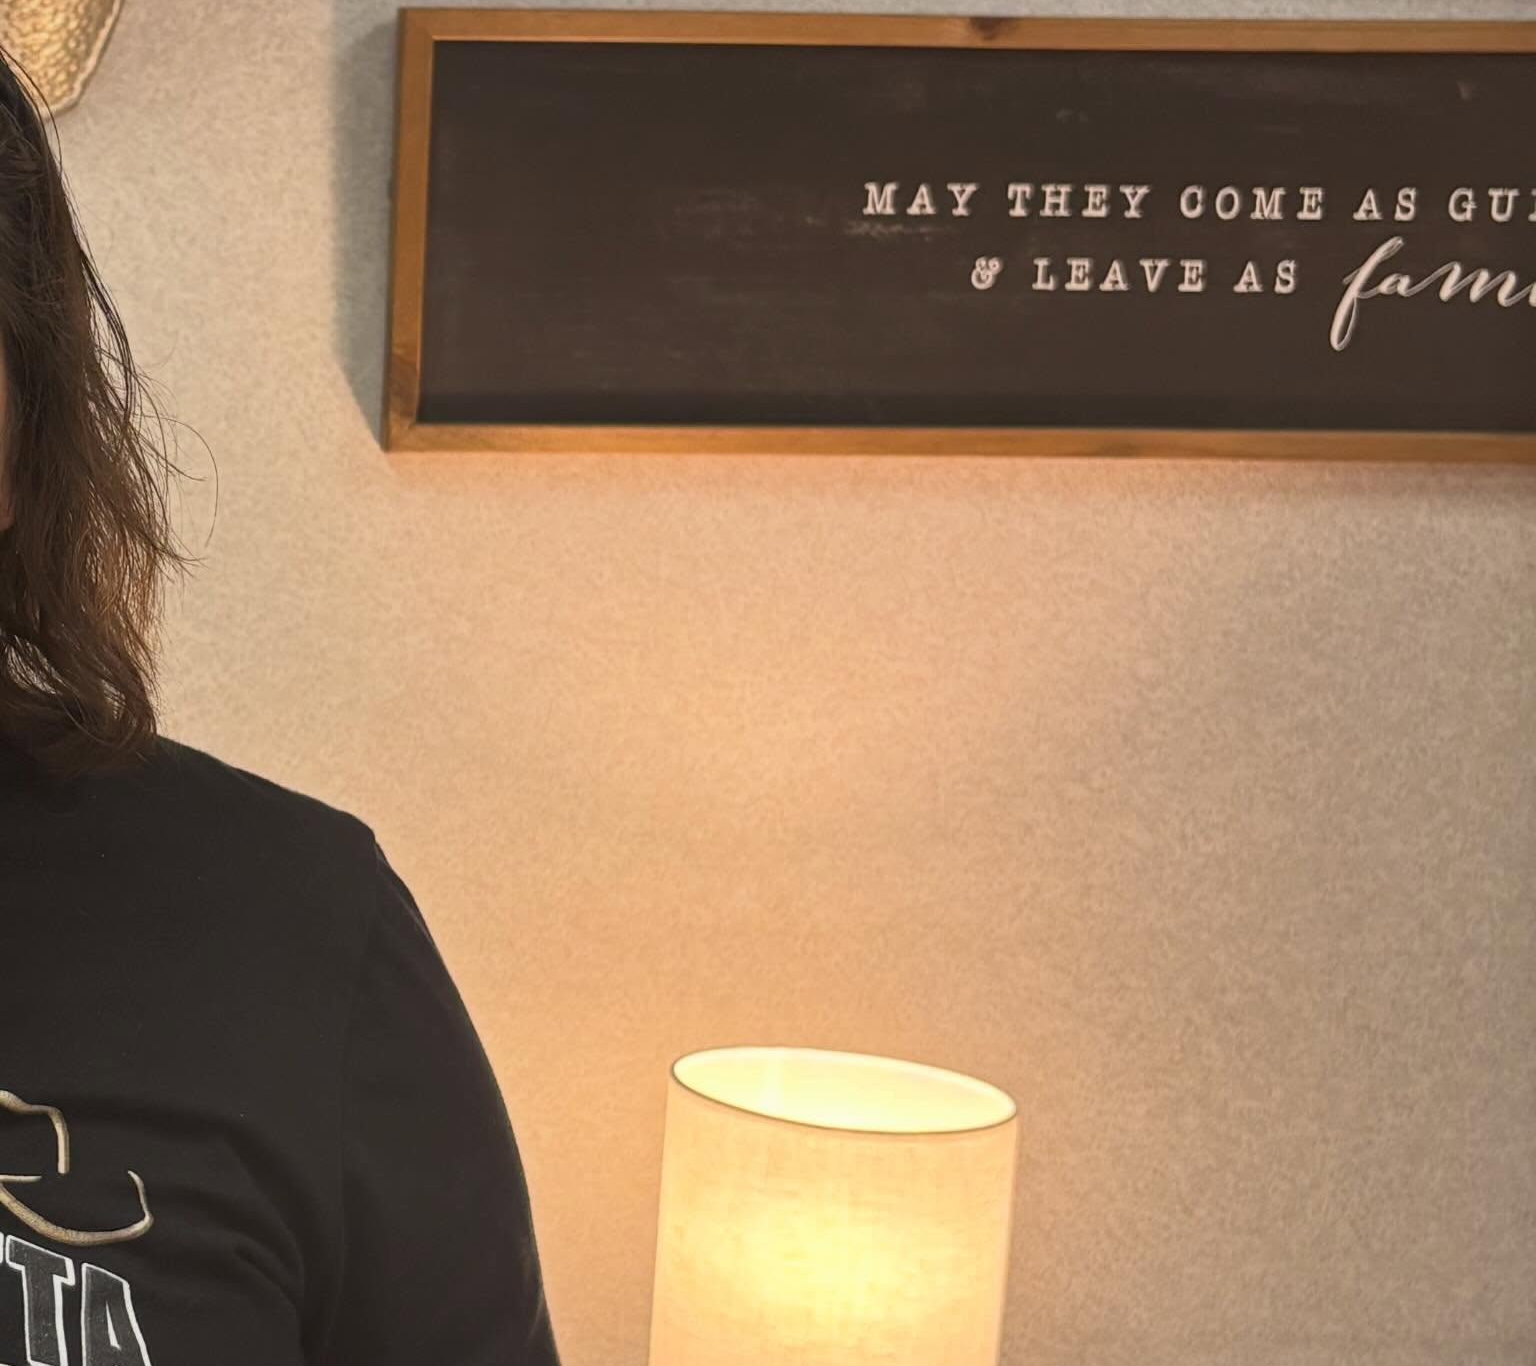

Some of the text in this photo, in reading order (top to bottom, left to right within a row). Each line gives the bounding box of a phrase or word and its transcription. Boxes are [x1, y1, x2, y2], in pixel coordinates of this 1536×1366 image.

[862, 181, 978, 217] MAY
[1007, 183, 1151, 219] THEY
[1179, 185, 1324, 221] COME
[1353, 187, 1418, 222] AS
[970, 256, 1004, 291] &
[1031, 257, 1207, 294] LEAVE
[1233, 259, 1298, 295] AS
